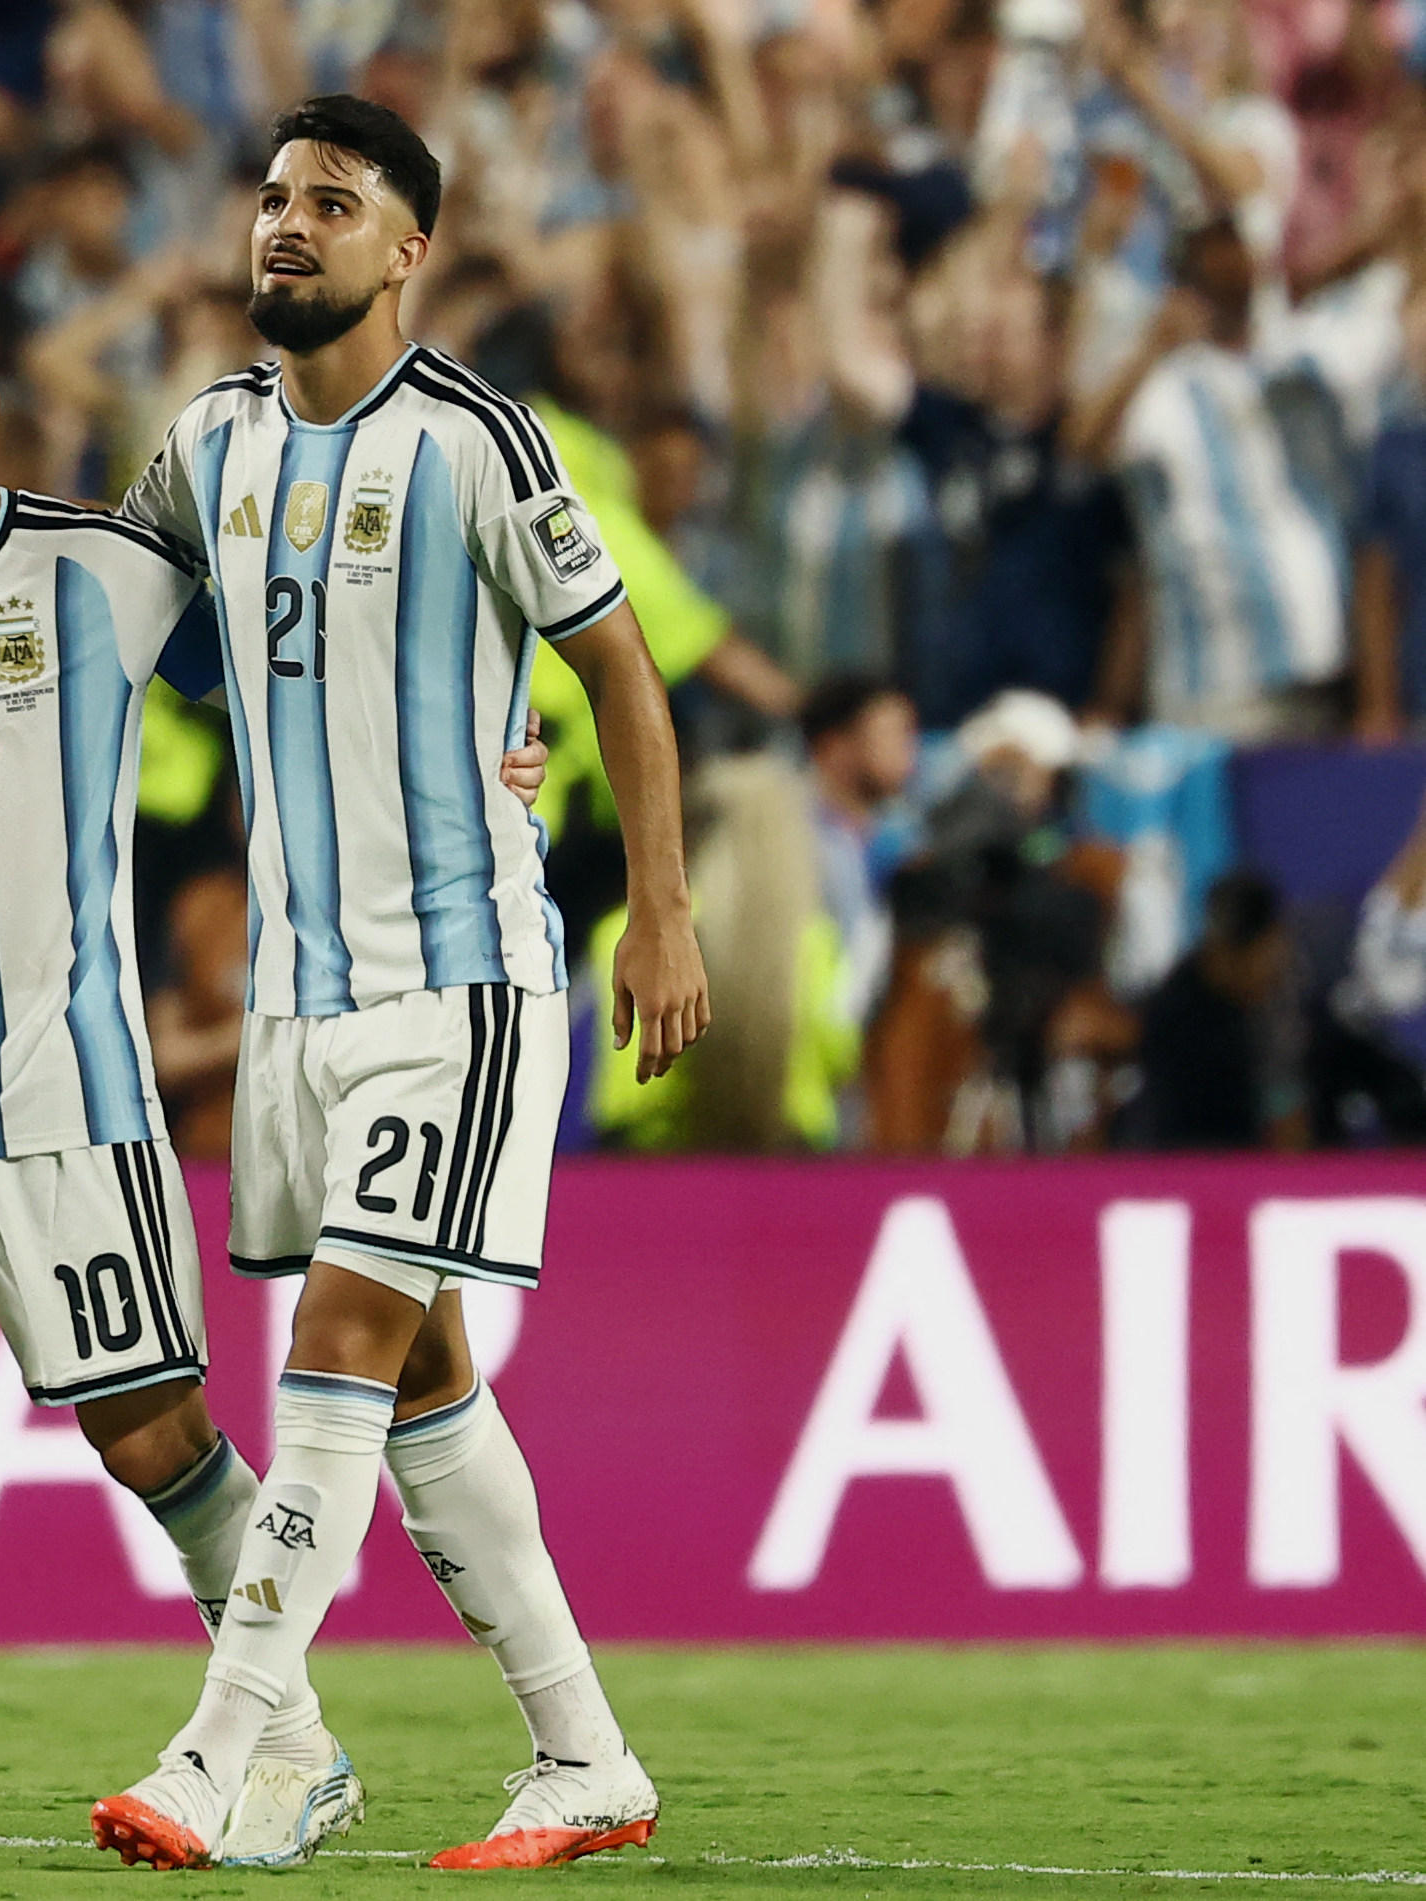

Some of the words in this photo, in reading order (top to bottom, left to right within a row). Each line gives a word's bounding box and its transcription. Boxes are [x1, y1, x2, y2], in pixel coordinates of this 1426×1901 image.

[1, 634, 34, 666] AFA
[265, 575, 328, 682] 21
[355, 1114, 444, 1222] 21
[54, 1252, 142, 1361] 10
[746, 1194, 1426, 1593] AIR
[255, 1501, 317, 1551] AFA
[419, 1551, 466, 1583] FA
[562, 1813, 614, 1831] ULTRA
